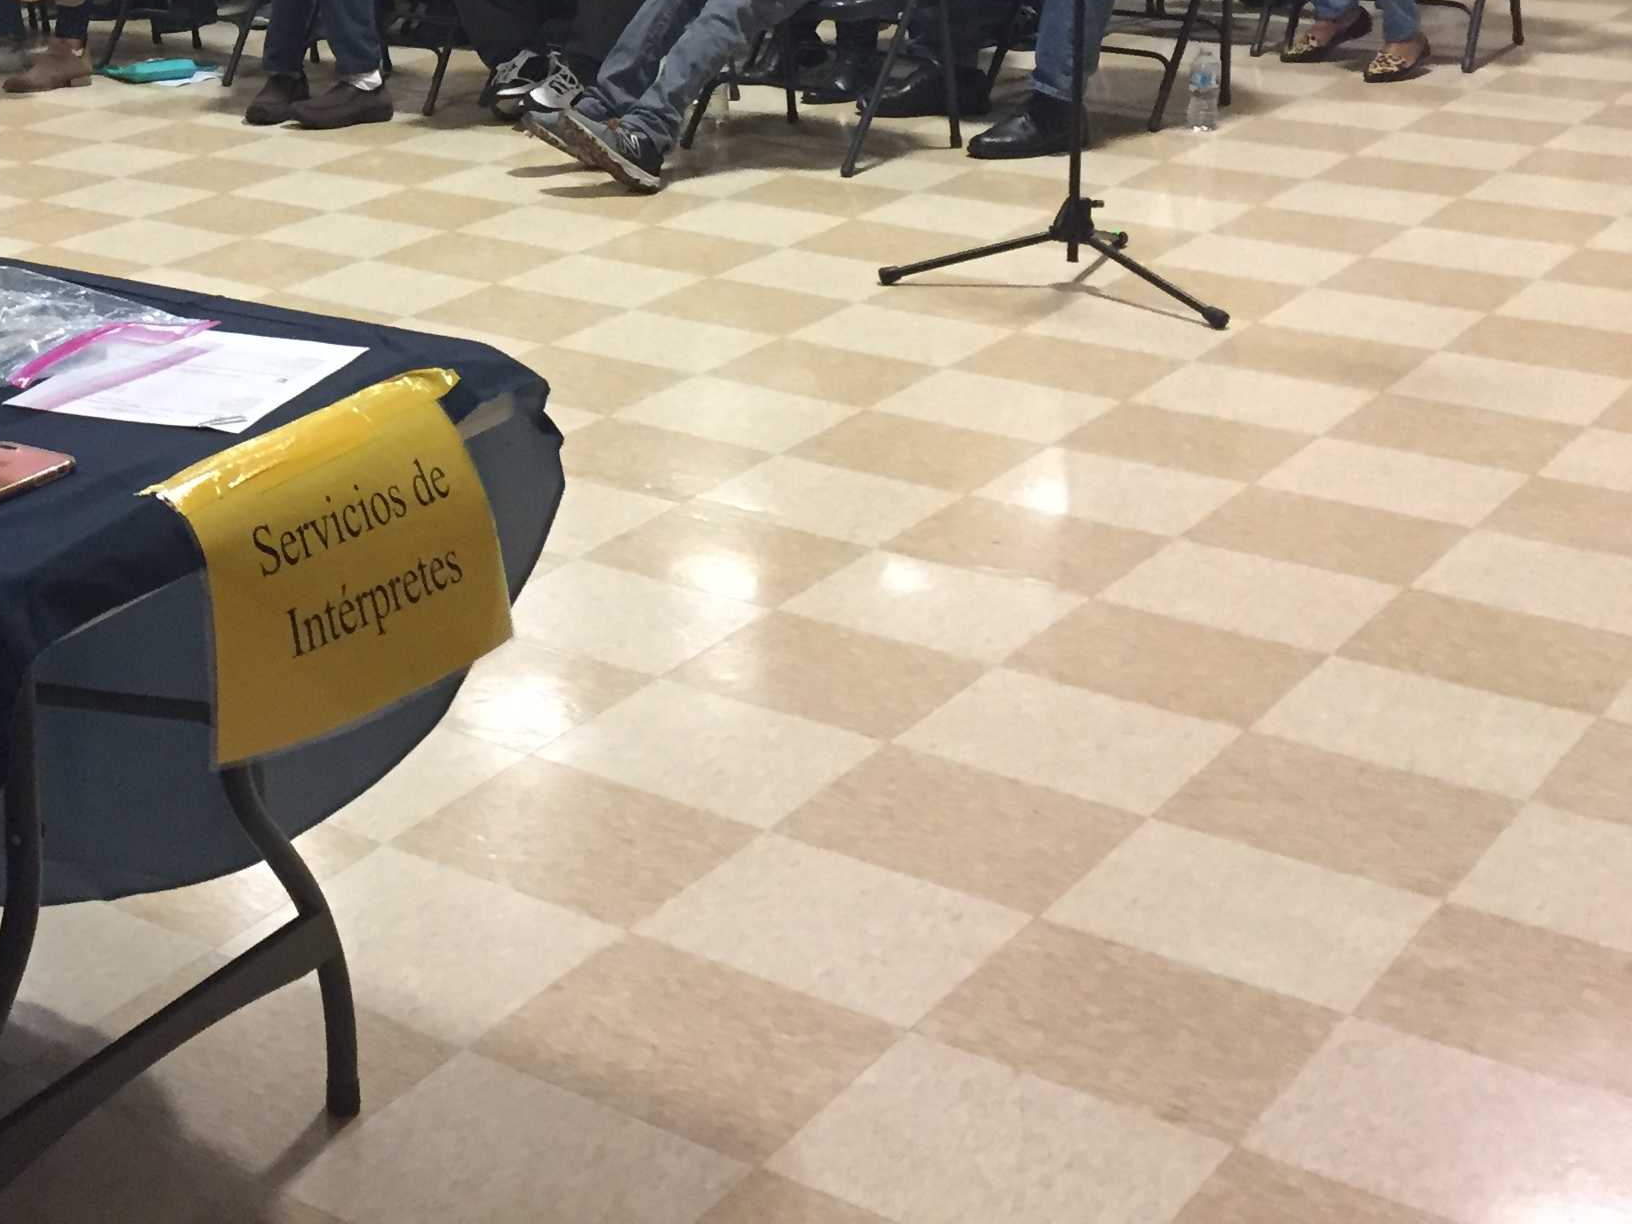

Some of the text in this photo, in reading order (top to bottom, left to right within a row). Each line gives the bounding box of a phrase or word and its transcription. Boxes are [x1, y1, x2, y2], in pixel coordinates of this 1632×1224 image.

[253, 460, 451, 577] Servicios de
[287, 550, 464, 658] Intérpretes
